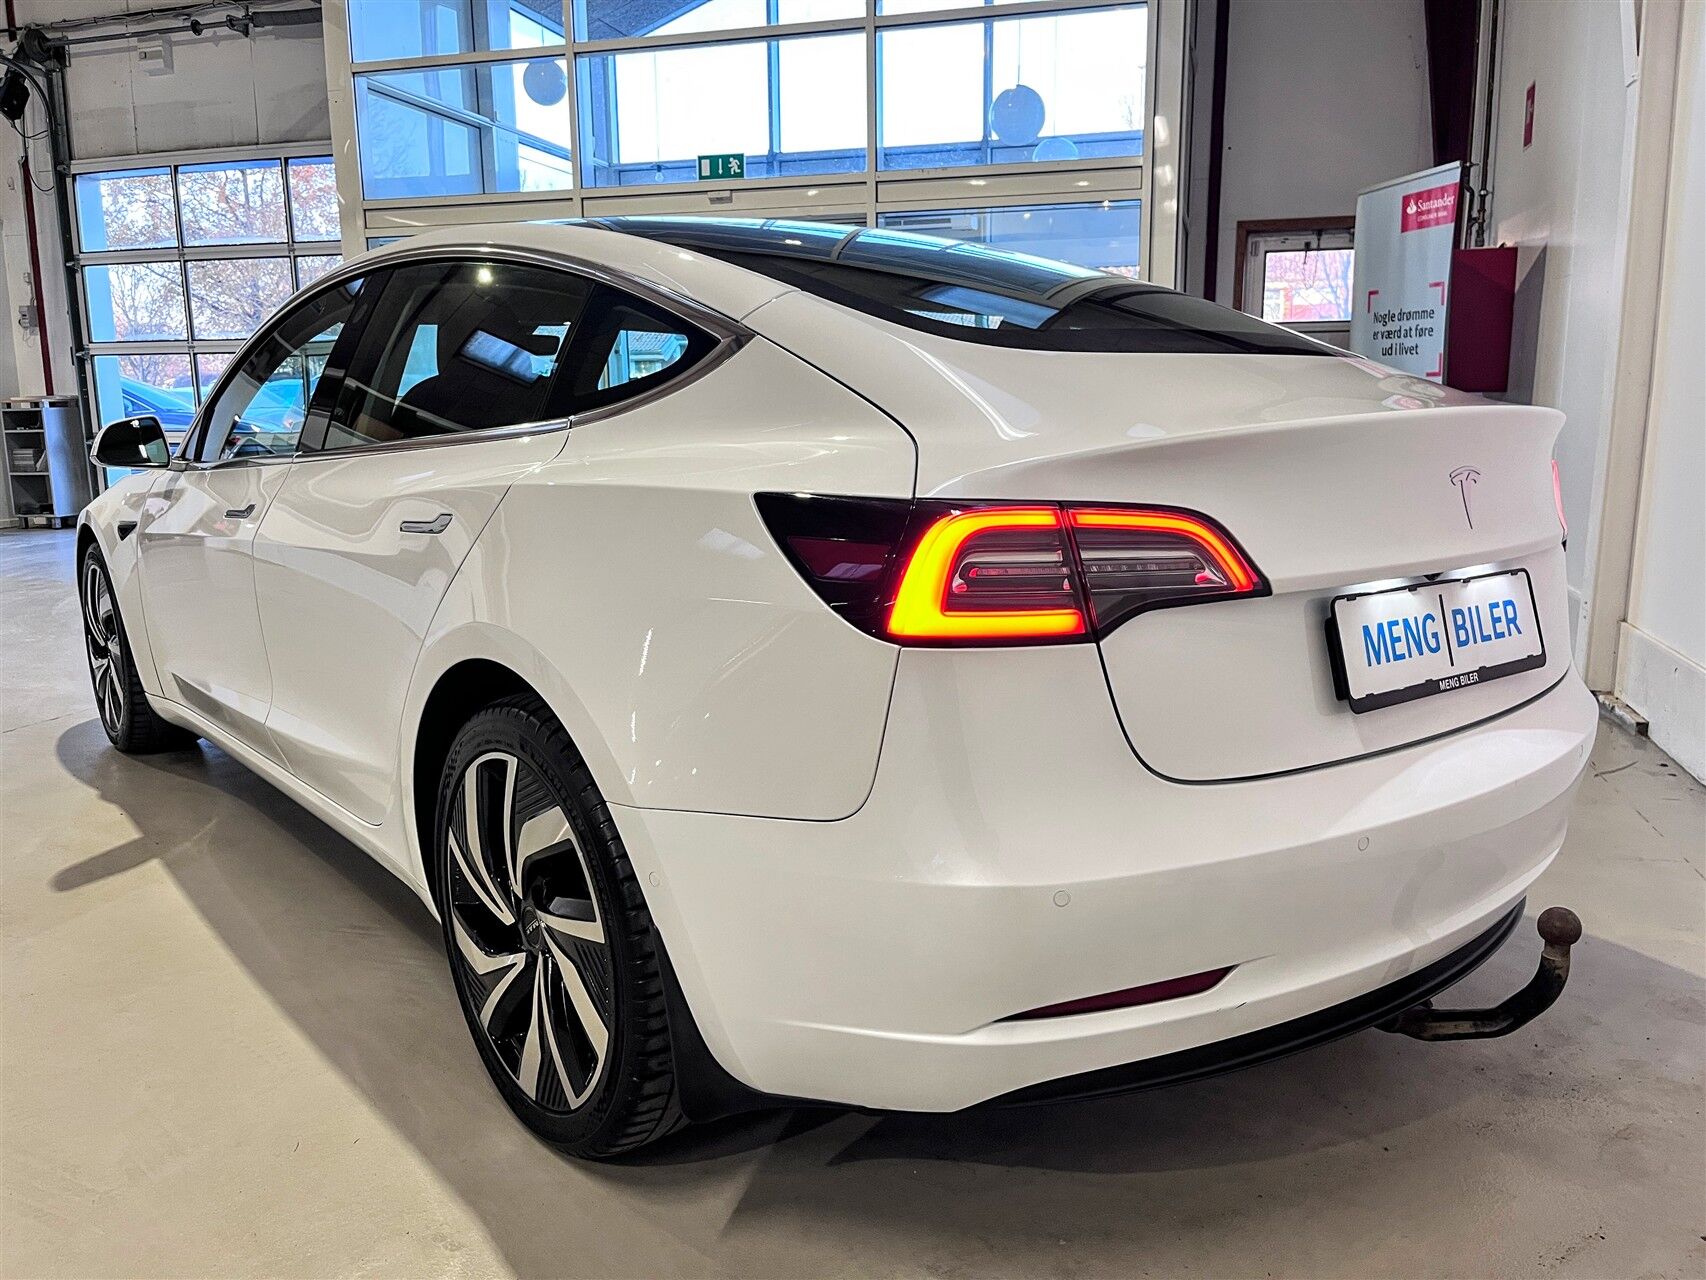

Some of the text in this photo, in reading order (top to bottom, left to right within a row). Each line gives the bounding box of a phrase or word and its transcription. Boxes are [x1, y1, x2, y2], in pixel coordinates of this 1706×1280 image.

[1417, 193, 1455, 212] Santander
[1373, 308, 1435, 327] Nogle drømme
[1372, 324, 1434, 340] er værd at føre
[1381, 343, 1393, 356] ud
[1399, 342, 1419, 356] livet
[1362, 599, 1523, 667] MENG BILER
[1439, 672, 1479, 691] MENG BILER
